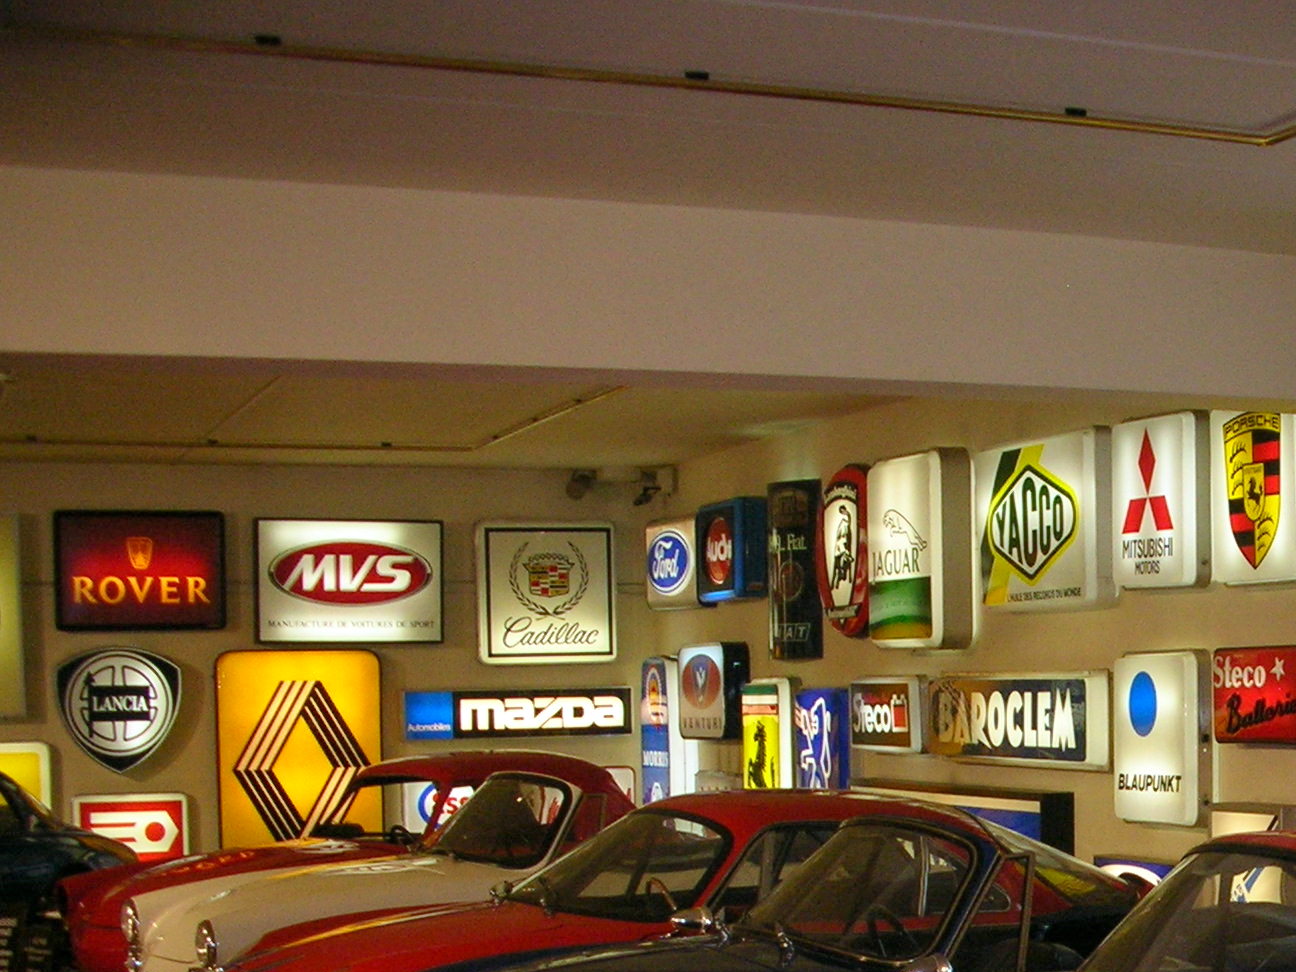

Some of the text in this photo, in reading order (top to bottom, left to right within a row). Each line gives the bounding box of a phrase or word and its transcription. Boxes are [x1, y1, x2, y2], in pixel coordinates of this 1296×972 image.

[1225, 414, 1280, 436] PORSCHE
[995, 476, 1064, 568] YACCO
[652, 540, 680, 580] Ford
[1121, 536, 1174, 560] MITSUBISHI
[282, 553, 417, 592] MVS
[872, 547, 920, 584] JAGUAR
[1134, 560, 1161, 575] MOTORS
[72, 576, 211, 604] ROVER
[410, 620, 435, 629] SPORT
[502, 616, 600, 649] Cadillac
[1212, 655, 1267, 689] Steco
[92, 695, 149, 712] LANCIA
[852, 692, 891, 734] Steco
[407, 722, 452, 733] Automobiles
[683, 716, 722, 731] VENTURI
[934, 688, 1077, 752] BAROCLEM
[642, 750, 669, 768] MORRIS
[1117, 773, 1183, 794] BLAUPUNKT
